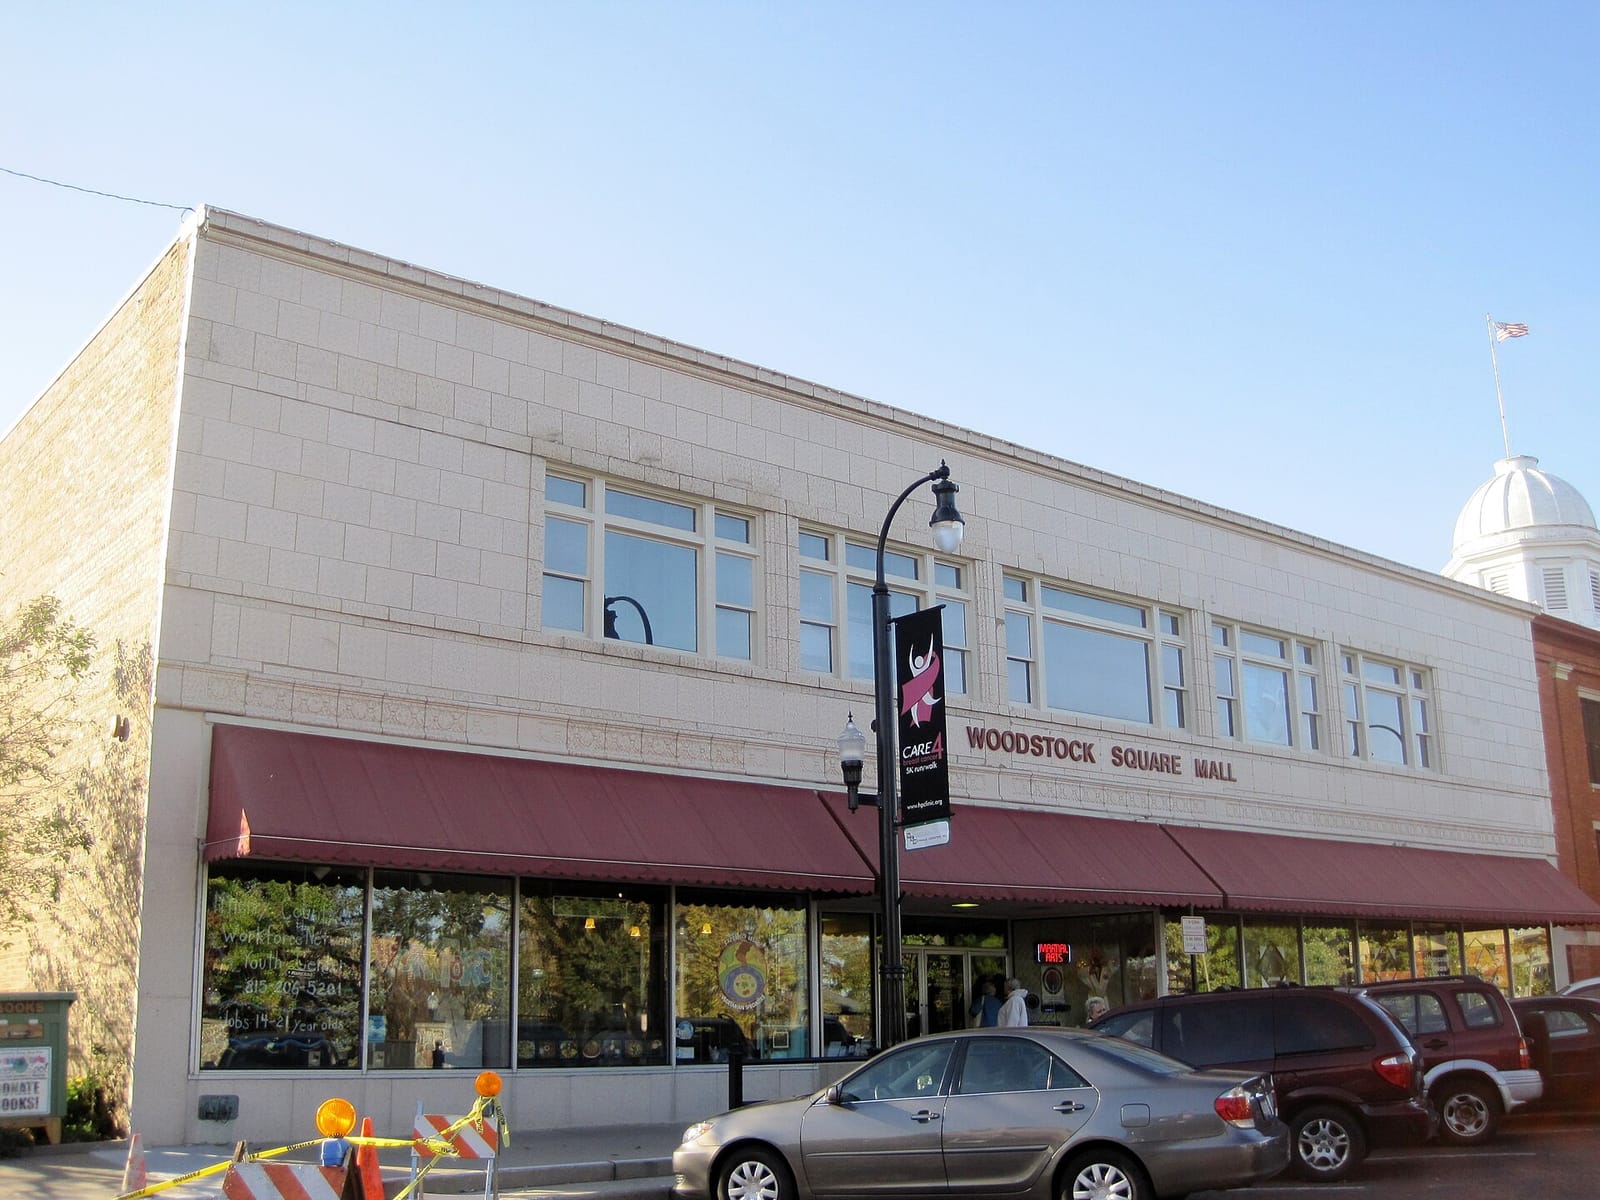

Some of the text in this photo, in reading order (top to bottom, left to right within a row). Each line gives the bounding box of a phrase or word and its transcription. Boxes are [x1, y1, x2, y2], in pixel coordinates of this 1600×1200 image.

[966, 725, 1237, 783] WOODSTOCK SQUARE MALL
[906, 766, 914, 775] 5K
[1039, 943, 1068, 954] MARTIAL
[1045, 953, 1064, 963] ARTS
[224, 1009, 249, 1030] Jobs
[291, 1018, 317, 1034] year
[320, 1016, 344, 1031] olds
[0, 1081, 40, 1096] ONATE
[1, 1096, 40, 1111] OOKS!
